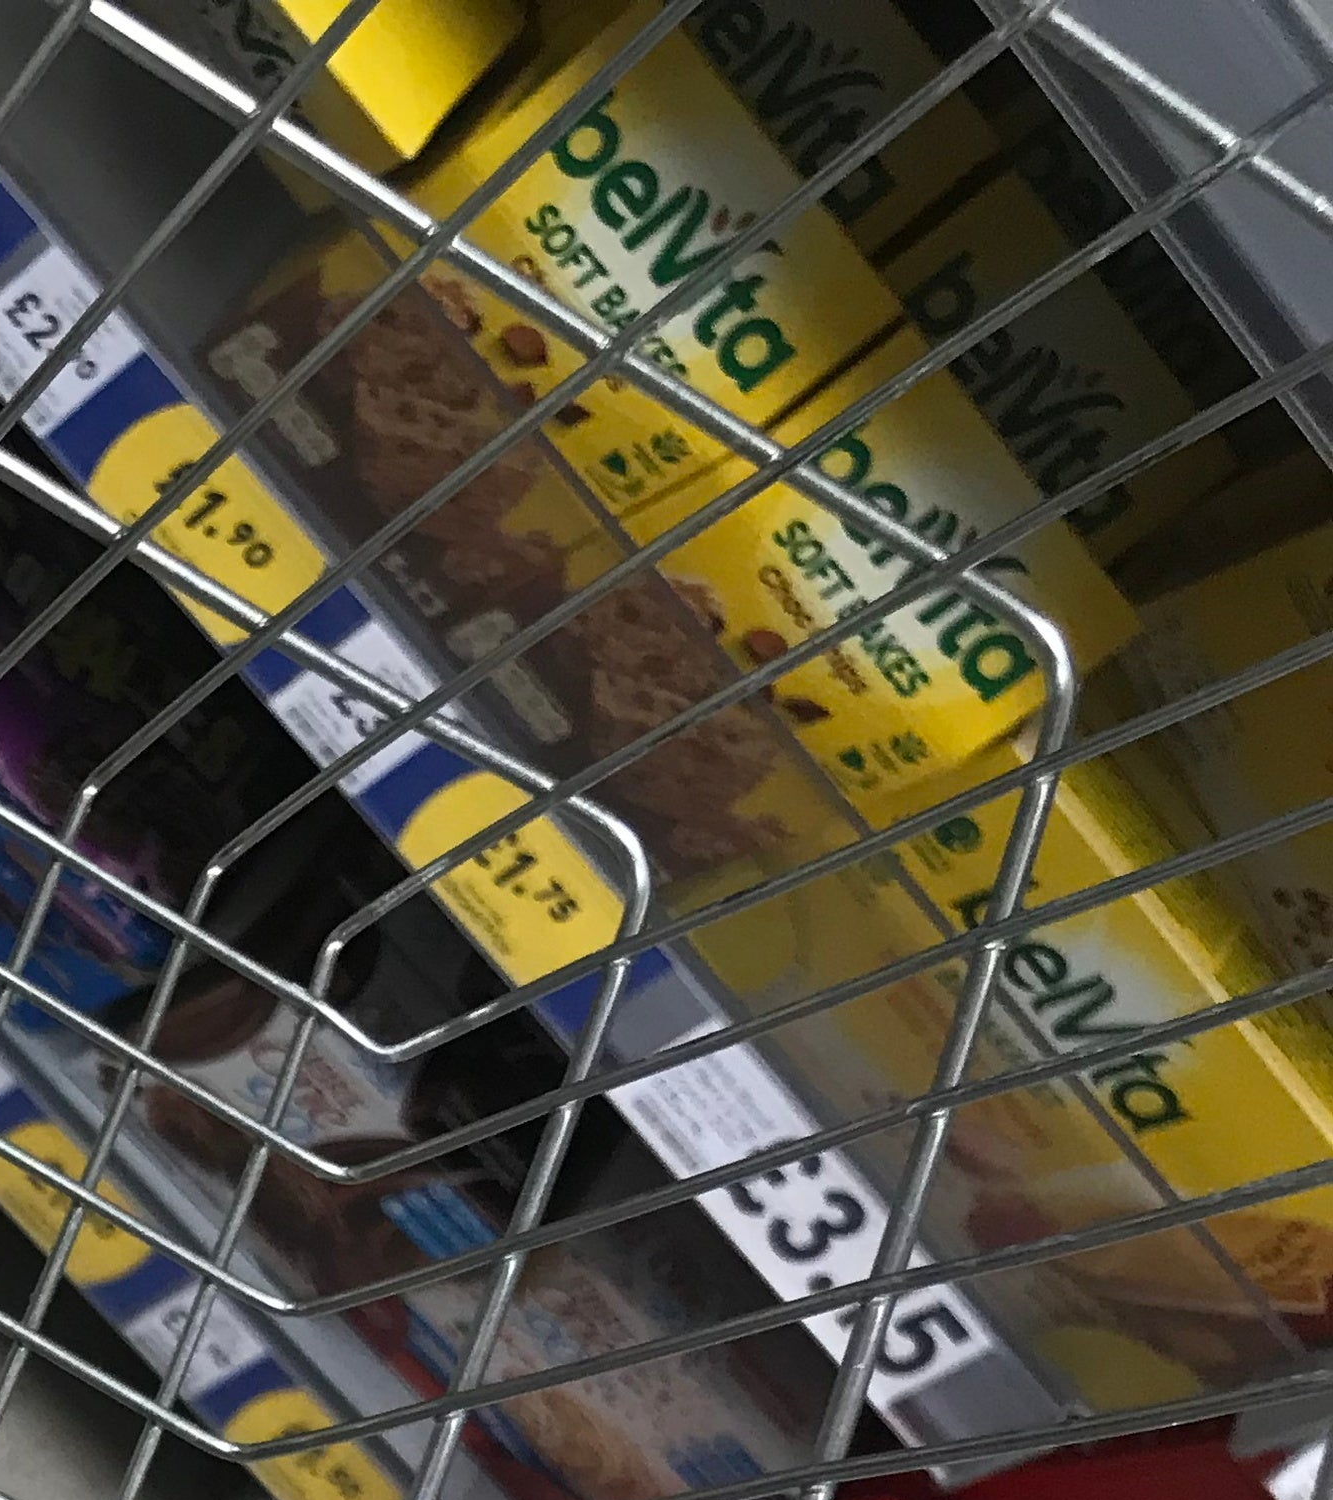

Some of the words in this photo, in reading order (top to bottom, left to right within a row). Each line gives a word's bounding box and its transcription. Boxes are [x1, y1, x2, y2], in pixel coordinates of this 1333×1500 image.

[691, 0, 895, 226] elVita
[525, 203, 609, 288] SOFT
[591, 285, 688, 376] BAES
[551, 85, 797, 393] belVta
[772, 519, 856, 600] SOFT
[950, 880, 1191, 1134] elVta
[727, 1136, 972, 1373] £3.5
